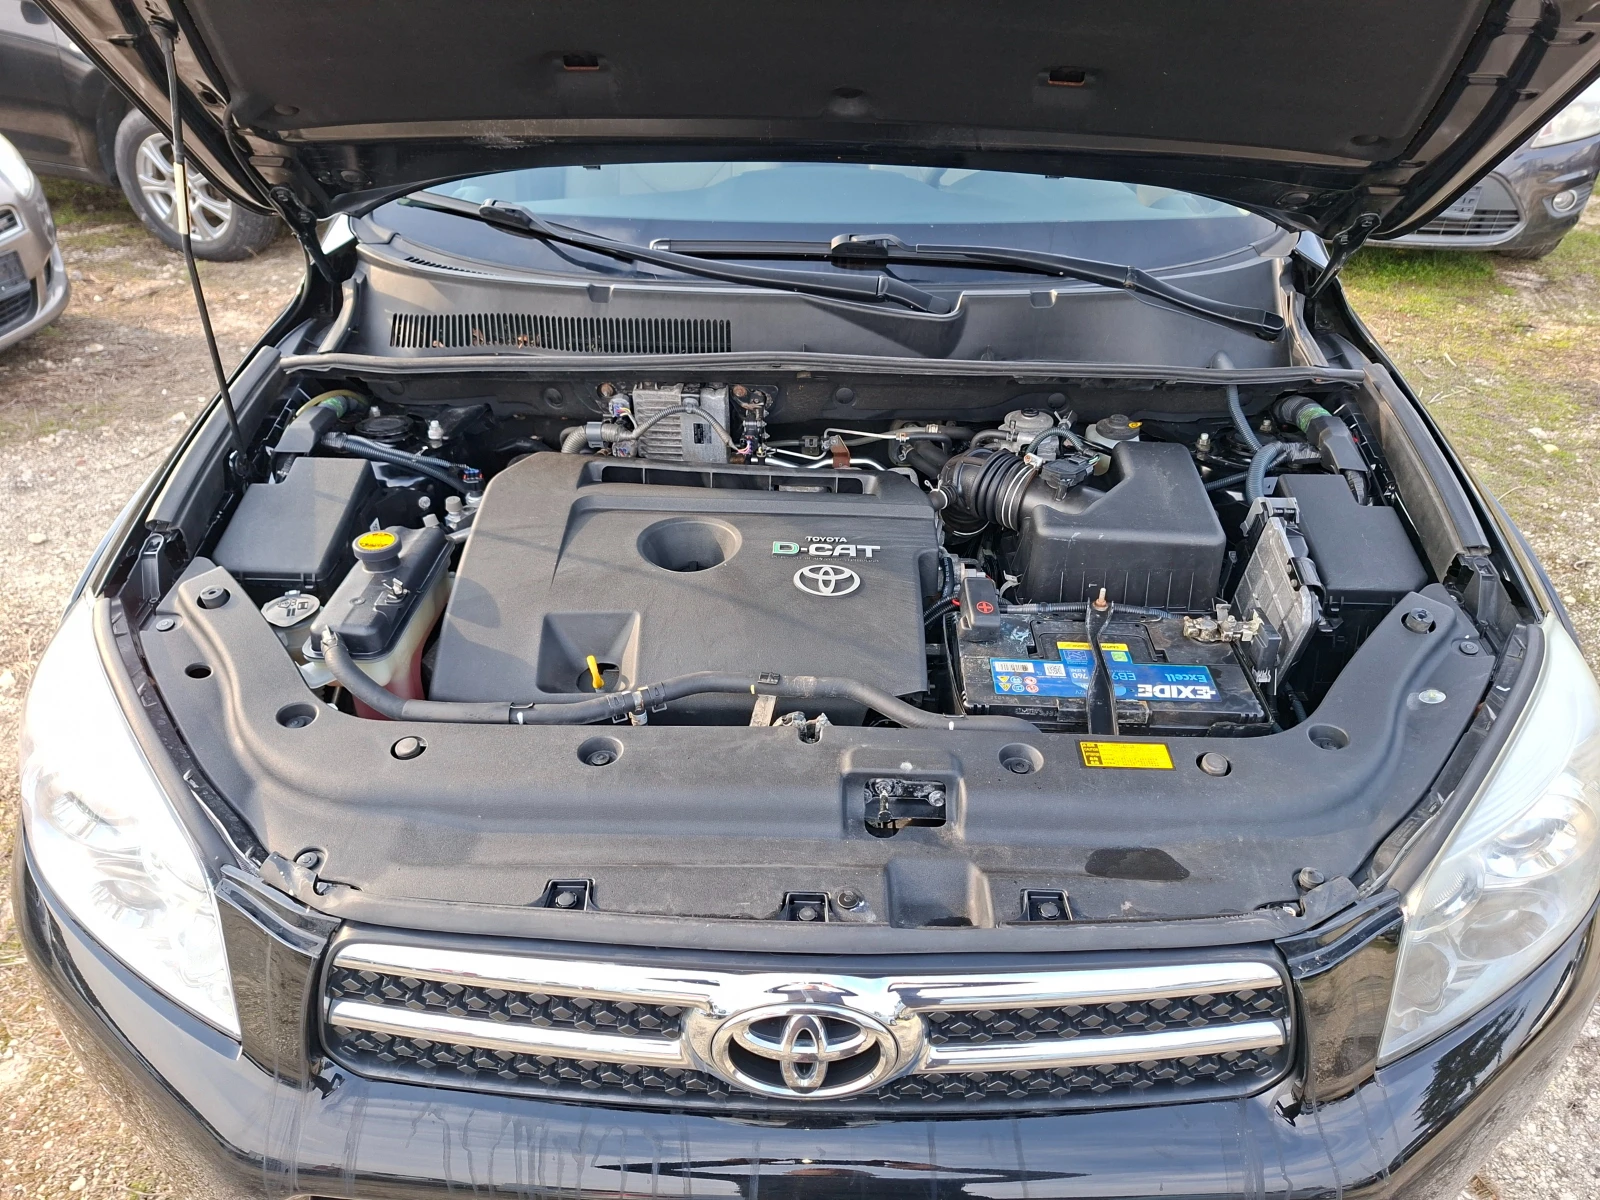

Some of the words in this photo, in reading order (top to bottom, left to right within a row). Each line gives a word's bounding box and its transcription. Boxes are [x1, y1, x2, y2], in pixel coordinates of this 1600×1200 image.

[772, 541, 881, 558] D-CAT
[1164, 673, 1208, 683] Excell
[1137, 684, 1216, 700] EXIDE
